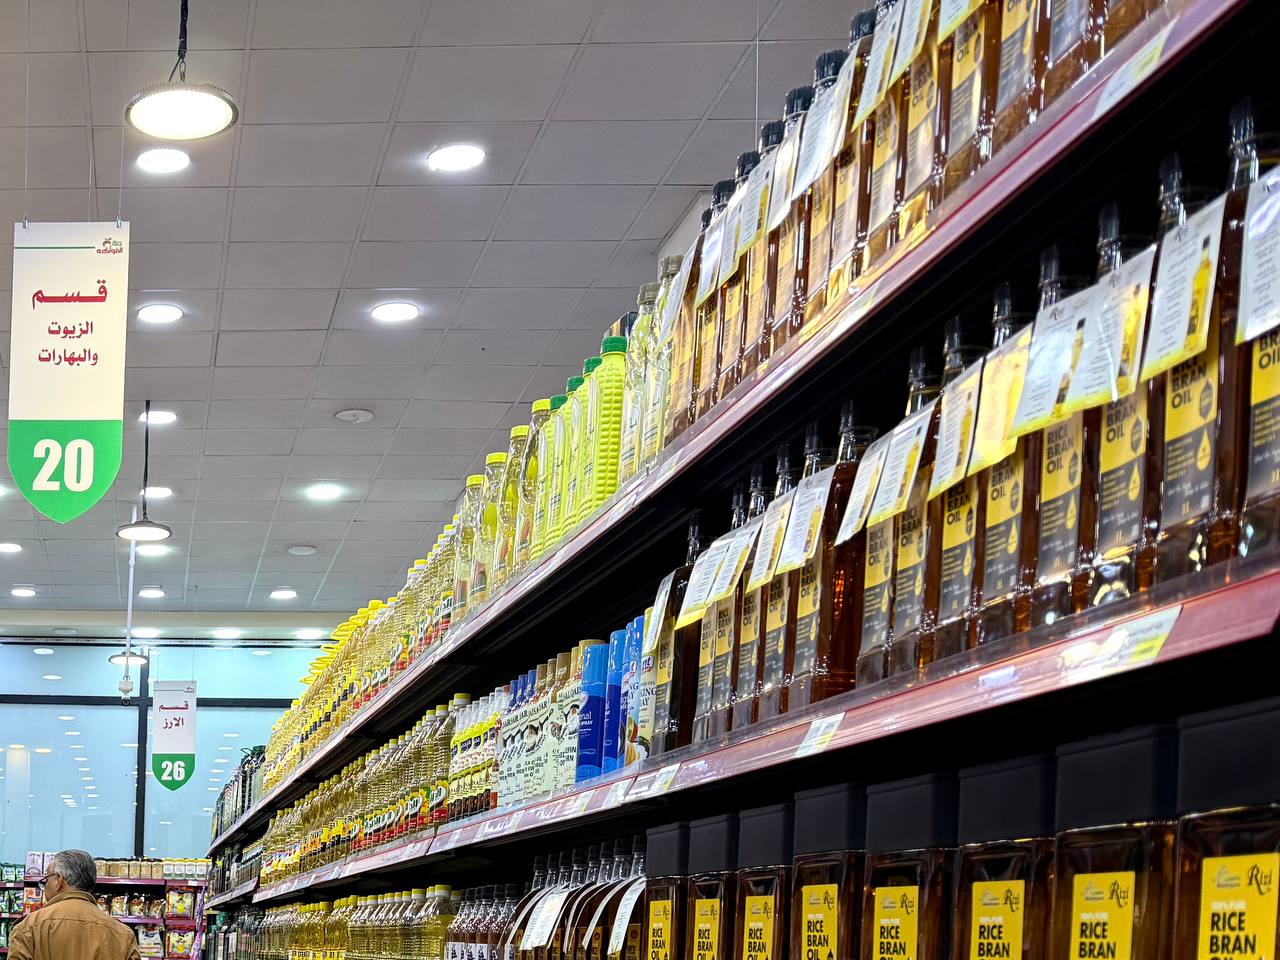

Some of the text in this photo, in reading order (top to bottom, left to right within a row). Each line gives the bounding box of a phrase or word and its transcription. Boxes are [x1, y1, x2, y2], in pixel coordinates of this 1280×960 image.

[32, 279, 108, 310] قسم
[48, 320, 94, 339] الزيوت
[38, 348, 98, 366] والبهارات
[1171, 363, 1206, 391] BRAN
[1171, 388, 1193, 409] OIL
[1106, 423, 1125, 444] OIL
[32, 438, 94, 492] 20
[1047, 455, 1064, 475] OIL
[159, 701, 188, 712] قسم
[161, 761, 185, 780] 26
[807, 920, 824, 933] RICE
[1080, 920, 1108, 939] RICE
[1211, 911, 1246, 933] RICE
[807, 935, 829, 948] BRAN
[879, 925, 900, 940] RICE
[979, 924, 1003, 940] RICE
[879, 941, 906, 955] BRAN
[977, 943, 1010, 958] BRAN
[1079, 942, 1116, 959] BRAN
[1209, 934, 1256, 955] BRAN
